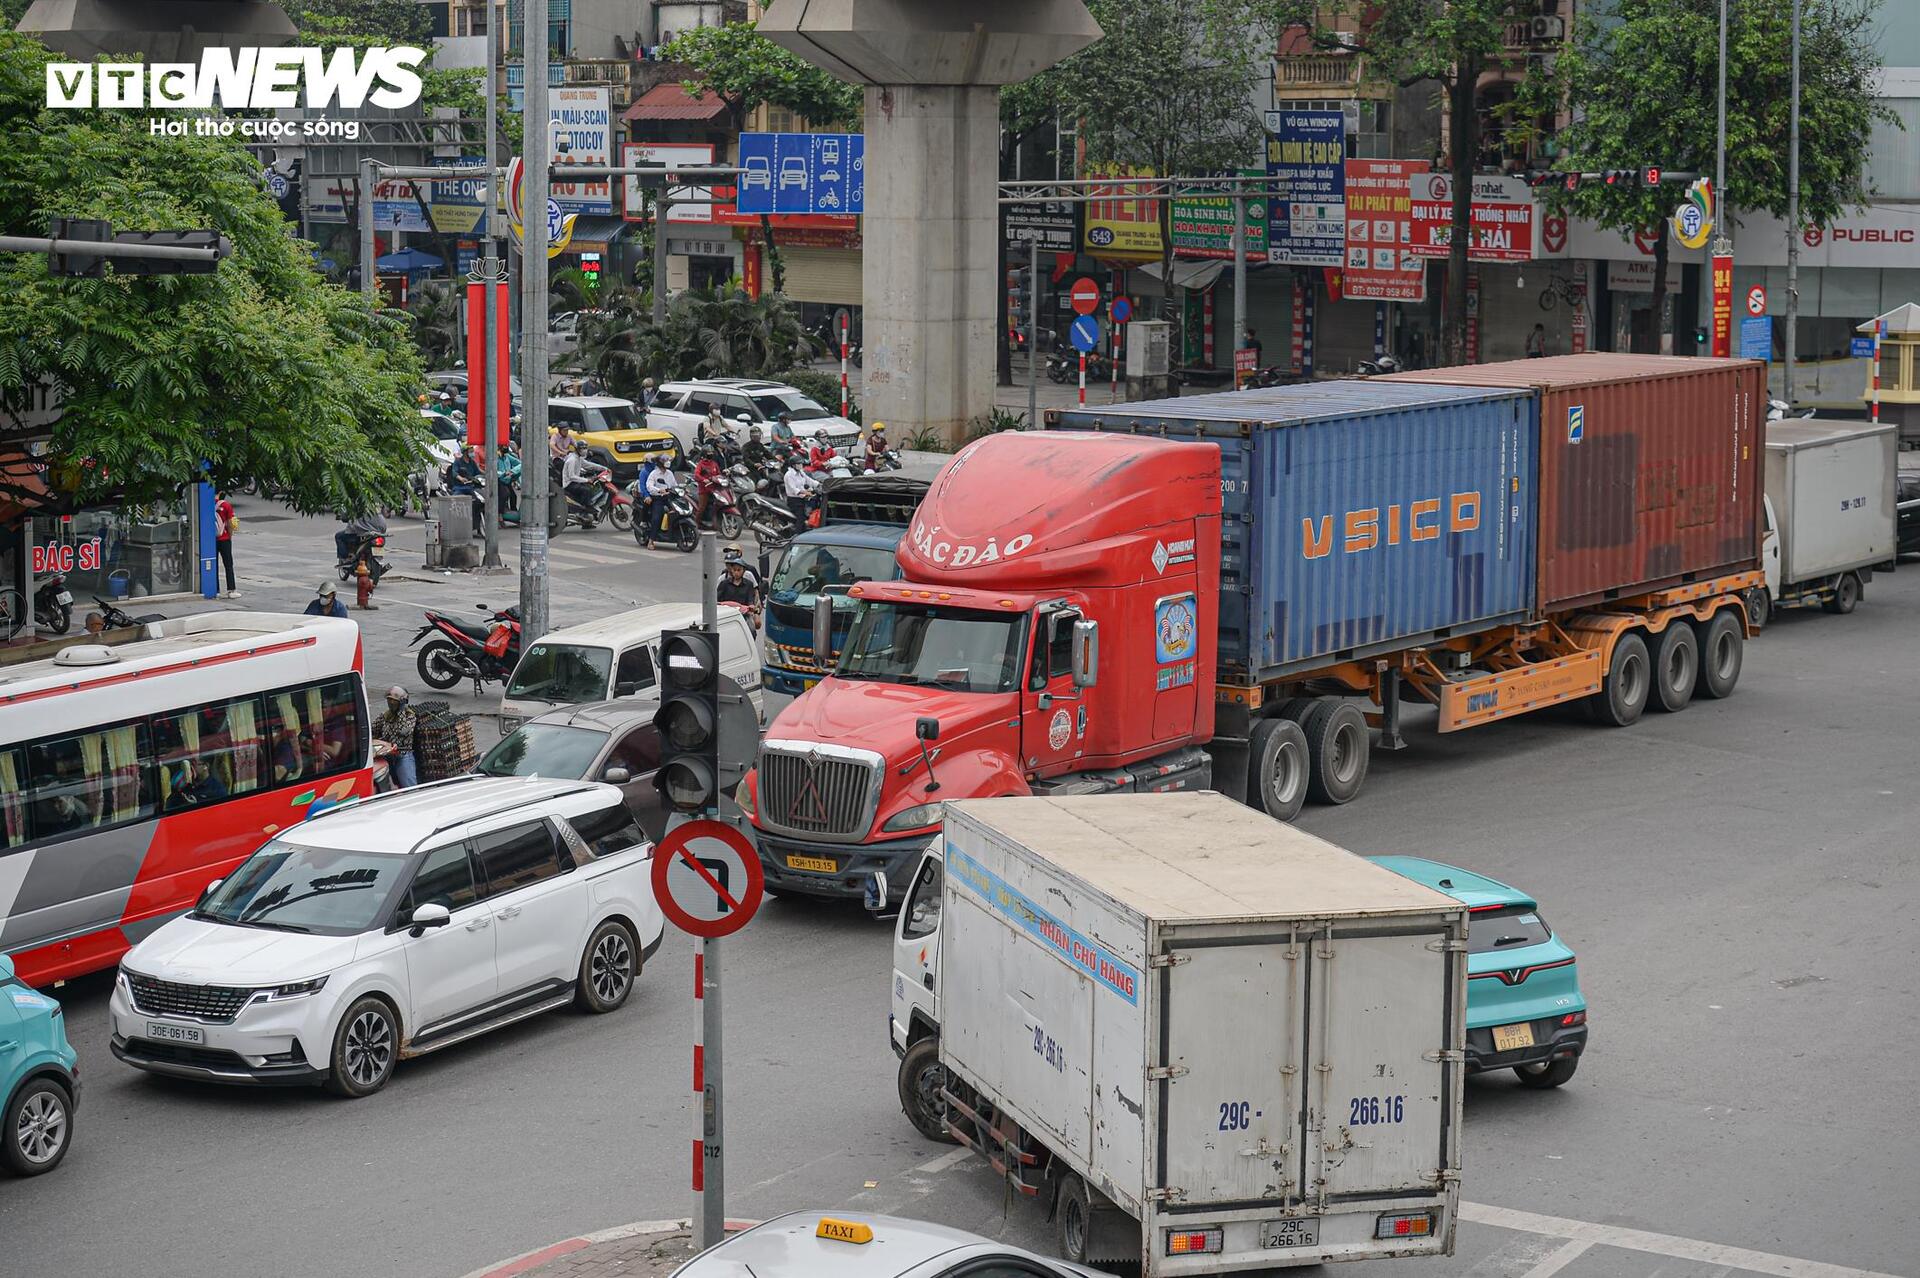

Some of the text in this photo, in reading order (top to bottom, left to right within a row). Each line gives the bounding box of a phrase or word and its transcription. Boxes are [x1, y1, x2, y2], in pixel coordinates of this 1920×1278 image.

[560, 91, 597, 100] QUANG TRUNG
[562, 107, 607, 125] MÀU-SCAN
[1297, 118, 1309, 127] GIA
[1309, 118, 1340, 127] WINDOW
[555, 131, 604, 150] POTOCOY
[437, 181, 459, 196] THE
[1366, 193, 1392, 212] PHÁT
[1174, 207, 1235, 223] HOA SINH NHẬ
[1412, 204, 1529, 223] ĐẠI LÝ XE THỐNG NHẤT
[1174, 221, 1195, 233] HOA
[1091, 230, 1111, 244] 543
[1480, 223, 1511, 249] HẢI
[1832, 228, 1914, 242] PUBLIC
[1272, 251, 1289, 261] 547
[1627, 263, 1649, 273] ATM
[1241, 481, 1249, 494] 7
[914, 520, 951, 563] BẮC
[32, 536, 102, 573] BÁC SĨ
[1099, 959, 1134, 997] HÀNG
[1219, 1101, 1250, 1131] 29C
[1350, 1095, 1404, 1126] 266.16
[824, 1224, 854, 1239] TAXI
[1281, 1220, 1305, 1234] 29C
[1270, 1232, 1313, 1247] 266.16
